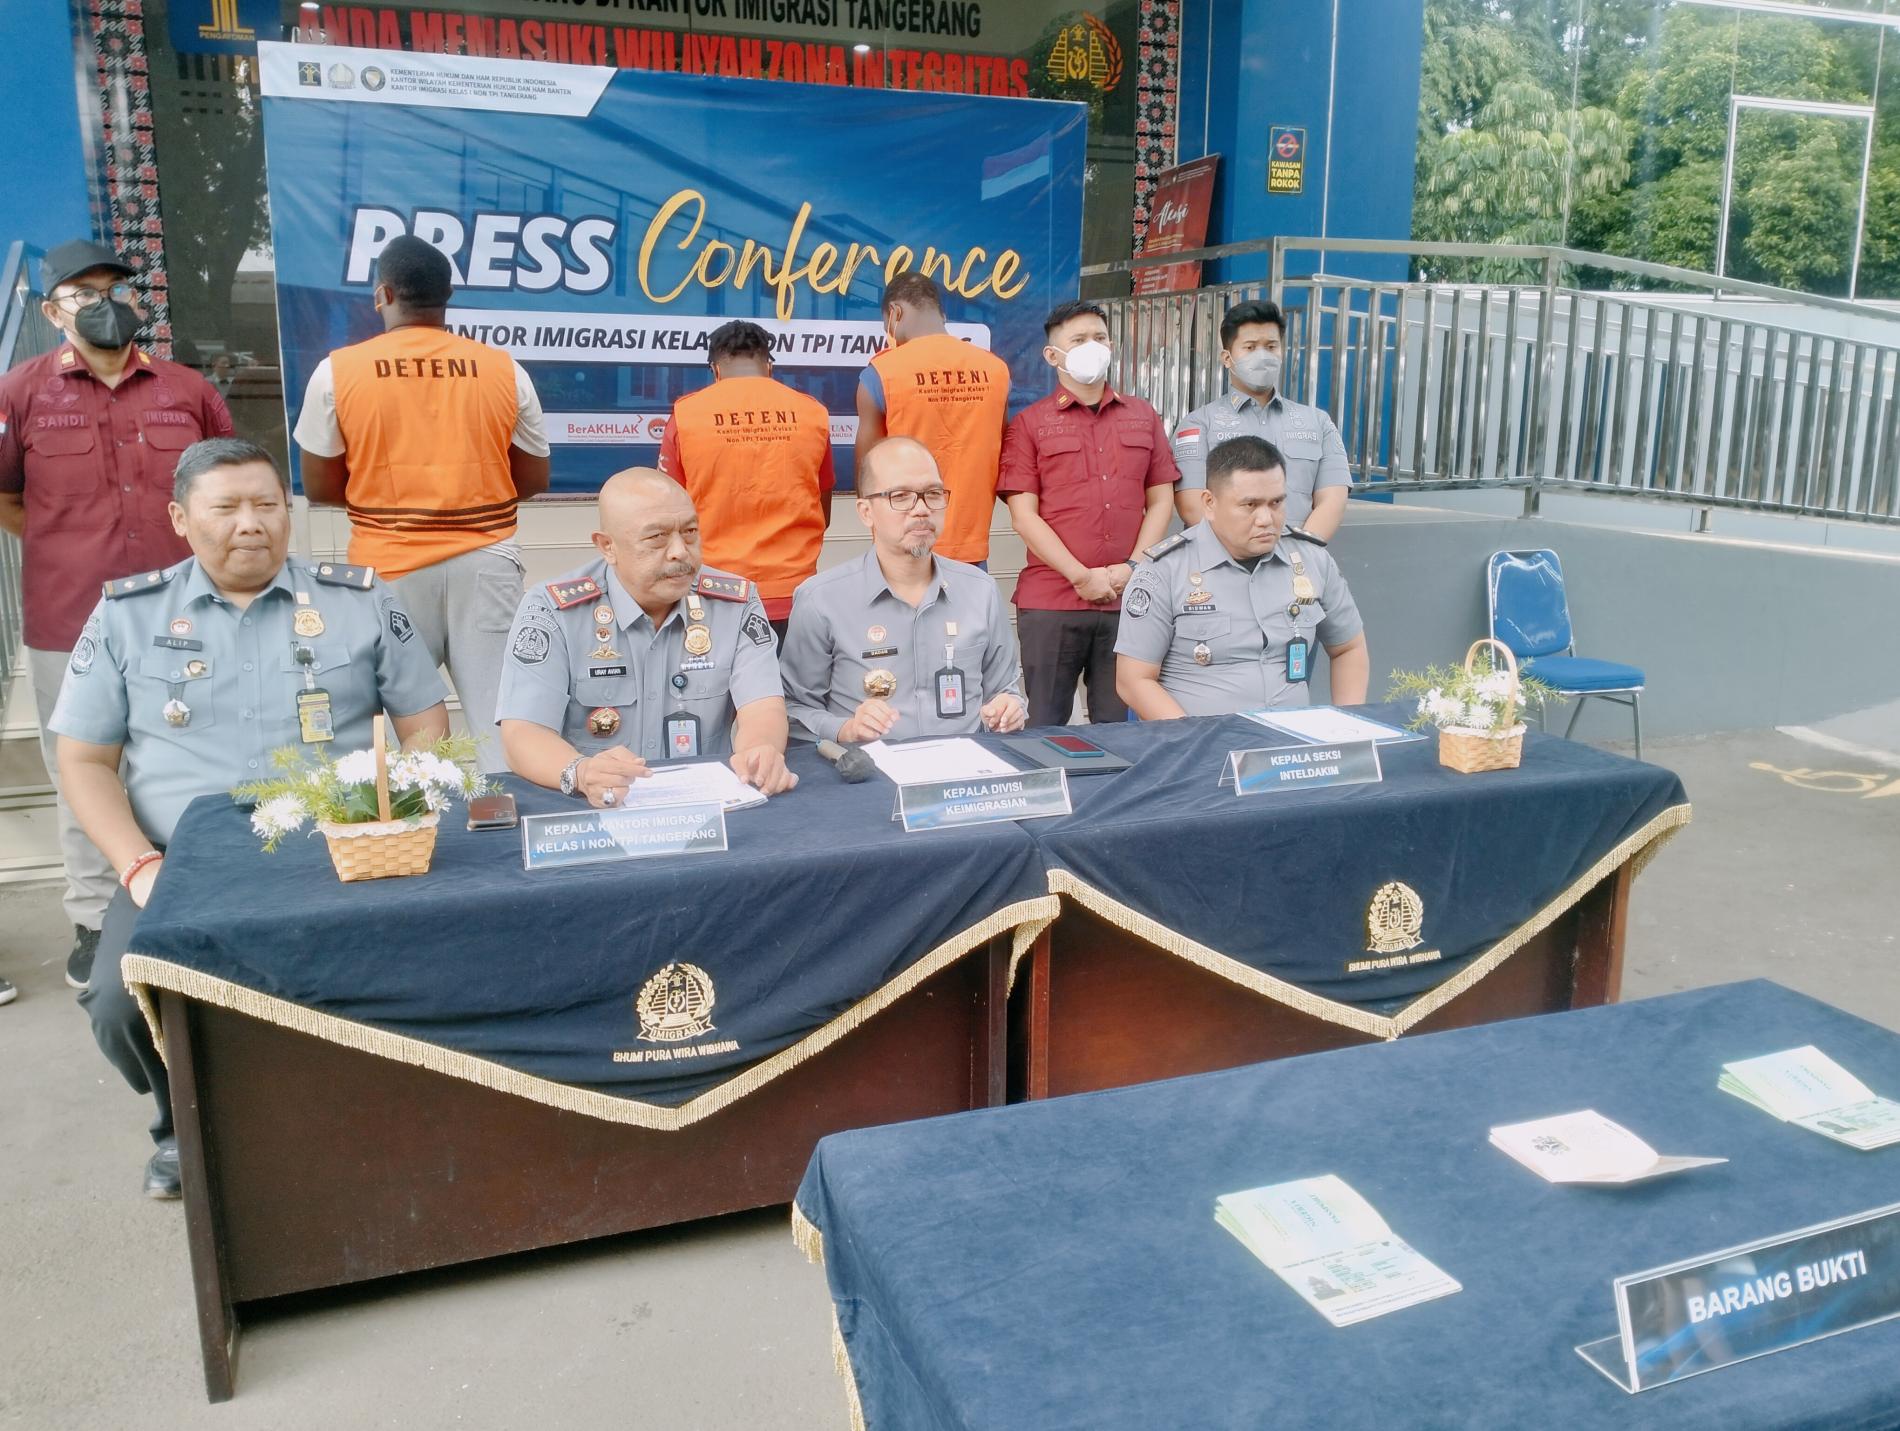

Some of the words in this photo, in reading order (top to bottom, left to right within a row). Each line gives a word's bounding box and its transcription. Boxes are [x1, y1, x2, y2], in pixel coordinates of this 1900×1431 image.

[849, 0, 981, 37] TANGERANG
[299, 5, 402, 50] ANDA
[391, 68, 435, 77] KEMENTERIAN
[436, 71, 460, 79] HUKUM
[491, 76, 521, 84] REPUBLIK
[523, 79, 557, 87] INDONESIA
[391, 76, 417, 84] KANTOR
[418, 78, 447, 86] WILAYAH
[448, 80, 492, 89] KEMENTERIAN
[493, 82, 516, 91] HUKUM
[391, 84, 417, 92] KANTOR
[419, 86, 447, 94] IMIGRASI
[500, 91, 537, 100] TANGERANG
[1271, 161, 1301, 169] KAWASAN
[1271, 169, 1301, 179] TANPA
[1270, 178, 1300, 189] ROKOK
[345, 206, 616, 293] PRESS
[638, 189, 1030, 321] Conference
[533, 326, 646, 349] IMIGRASI
[651, 329, 708, 351] KELA
[801, 333, 835, 354] TPI
[375, 358, 478, 379] DETENI
[916, 370, 989, 386] DETENI
[37, 414, 85, 428] SANDI
[714, 411, 797, 426] DETENI
[567, 423, 640, 434] BerAKHLAK
[755, 435, 791, 443] Tangerang
[166, 639, 188, 647] ALIP
[1270, 753, 1311, 766] KEPALA
[1313, 750, 1342, 762] SEKSI
[1280, 766, 1339, 781] INTELDAKIM
[943, 784, 989, 799] KEPALA
[990, 781, 1023, 795] DIVISI
[945, 797, 1027, 815] KEIMIGRASIAN
[544, 822, 595, 837] KEPALA
[598, 816, 649, 832] KANTOR
[652, 813, 707, 827] IMIGRASI
[536, 842, 578, 854] KELAS
[590, 838, 616, 850] NON
[620, 835, 640, 847] TPI
[642, 828, 717, 845] TANGERANG
[652, 1023, 699, 1040] IMIGRASI
[613, 1052, 643, 1063] BHUMI
[645, 1048, 672, 1061] PURA
[672, 1046, 698, 1059] WIRA
[1687, 1271, 1793, 1323] BARANG
[1796, 1250, 1868, 1293] BUKTI
